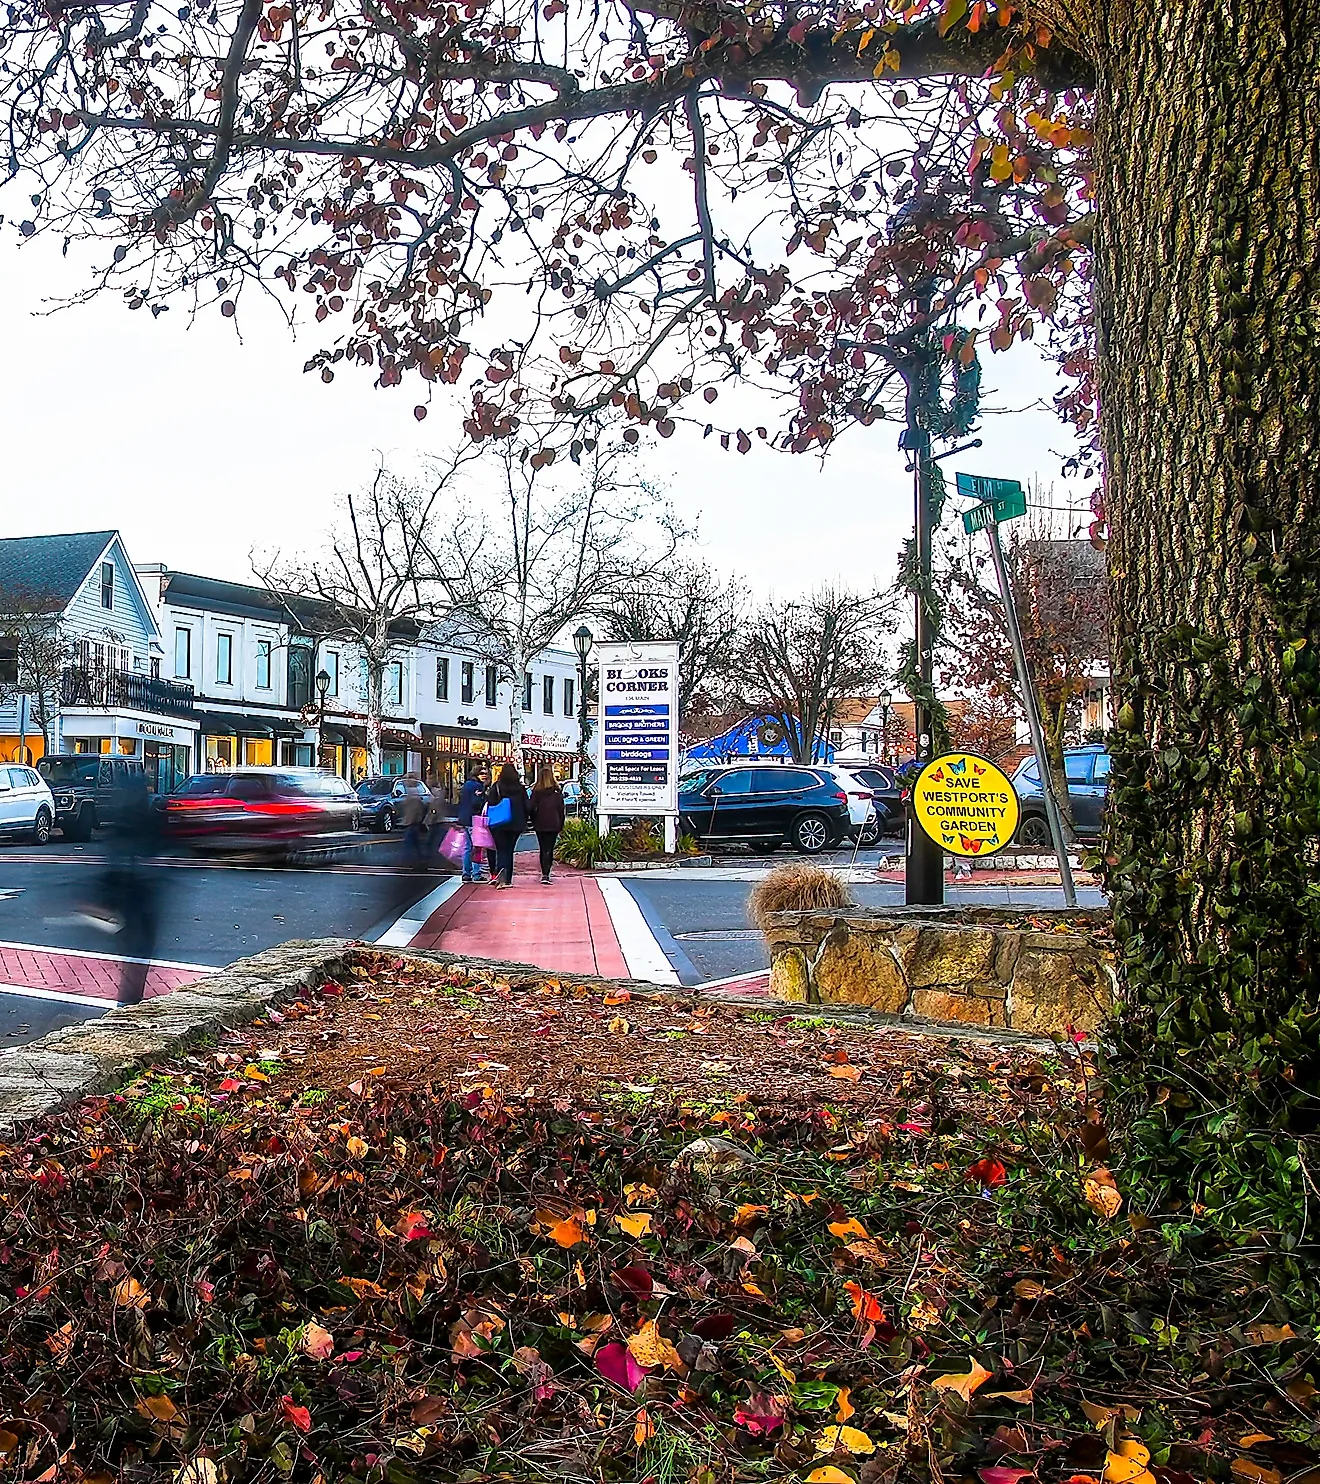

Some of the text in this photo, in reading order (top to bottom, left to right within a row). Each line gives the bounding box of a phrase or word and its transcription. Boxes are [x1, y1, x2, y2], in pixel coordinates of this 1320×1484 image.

[971, 479, 1003, 497] ELM ST
[969, 501, 1005, 530] MAIN ST
[606, 668, 669, 679] BOKS
[606, 681, 669, 692] CORNER
[620, 750, 652, 758] birddogs
[946, 778, 981, 788] SAVE
[922, 791, 1009, 804] WESTPORT'S
[926, 805, 1007, 818] COMMUNITY
[940, 820, 997, 832] GARDEN
